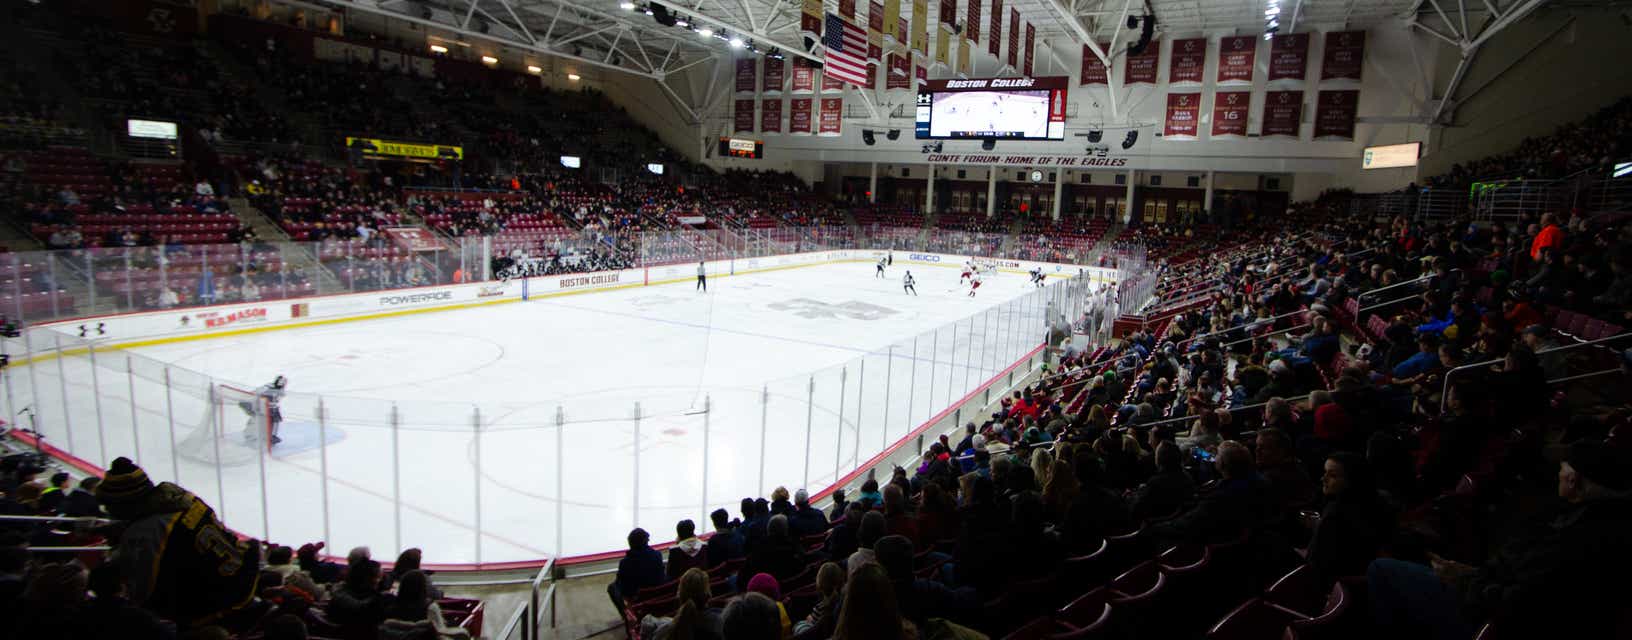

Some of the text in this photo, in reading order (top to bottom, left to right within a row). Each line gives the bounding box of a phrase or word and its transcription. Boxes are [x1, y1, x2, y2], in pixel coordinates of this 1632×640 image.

[946, 80, 987, 88] BOSTON
[1223, 111, 1238, 120] 16
[928, 154, 1128, 166] CONTE FORUM HOME OF THE EAGLES
[560, 274, 620, 288] BOSTON COLLEGE
